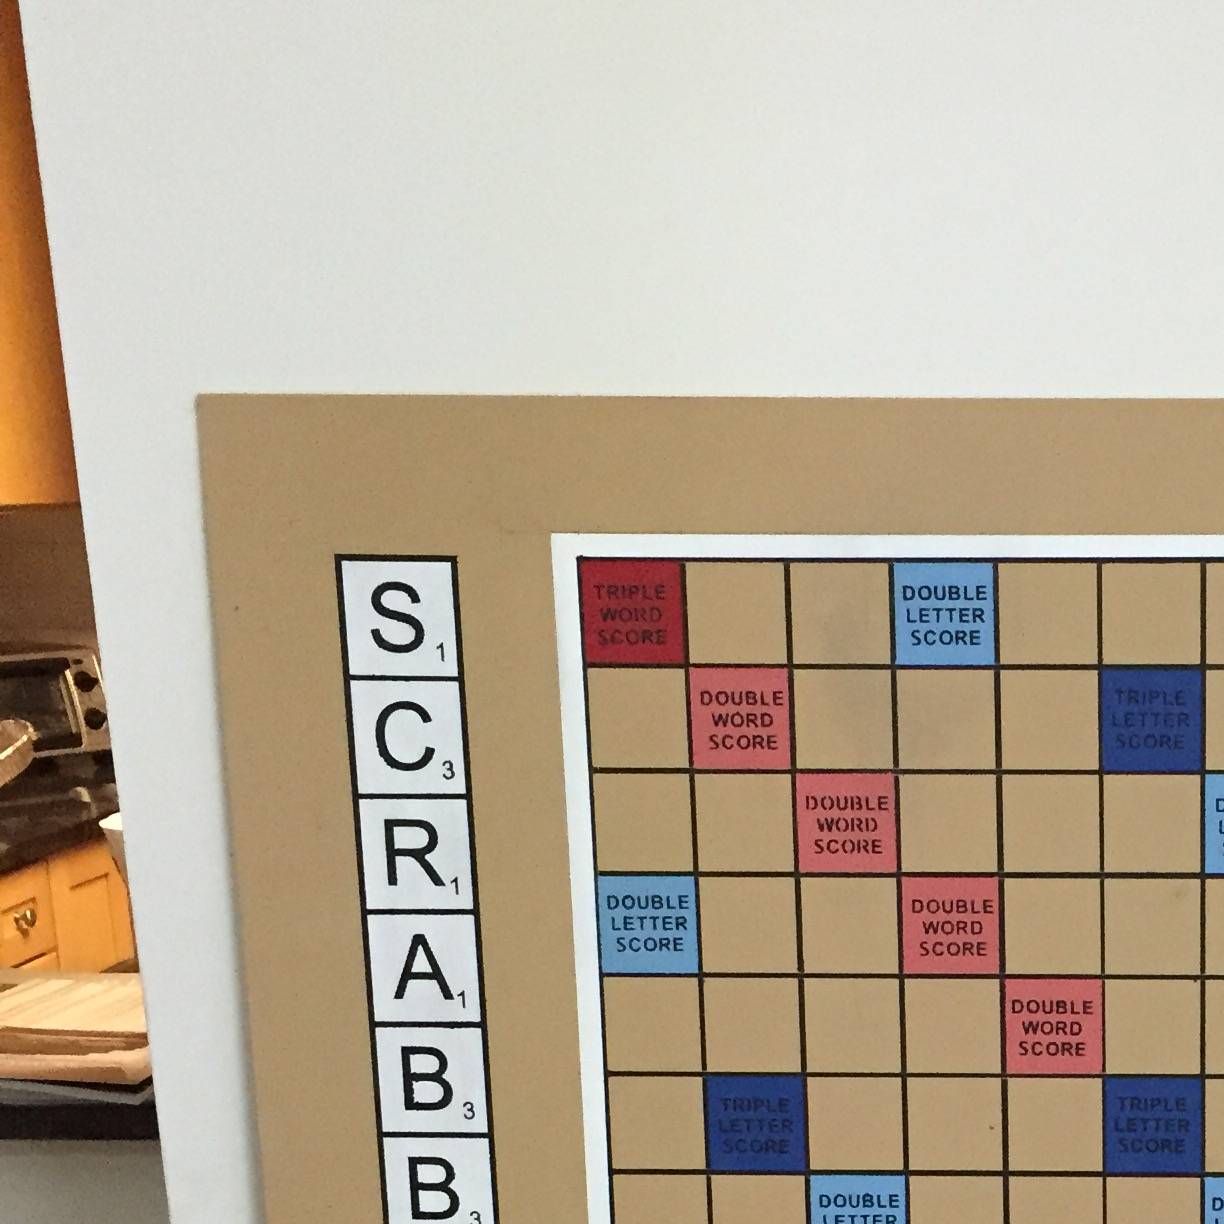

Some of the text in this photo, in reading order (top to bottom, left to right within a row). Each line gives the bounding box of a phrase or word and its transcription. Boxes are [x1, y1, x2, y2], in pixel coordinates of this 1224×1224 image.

[901, 585, 987, 601] DOUBLE
[906, 607, 985, 623] LETTER
[910, 629, 981, 646] SCORE
[699, 690, 783, 706] DOUBLE
[711, 712, 774, 728] WORD
[709, 734, 778, 750] SCORE
[606, 894, 689, 910] DOUBLE
[611, 915, 688, 931] LETTER
[616, 936, 683, 952] SCORE
[1011, 999, 1093, 1015] DOUBLE
[1021, 1020, 1083, 1036] WORD
[1018, 1041, 1085, 1057] SCORE
[818, 1192, 899, 1208] DOUBLE
